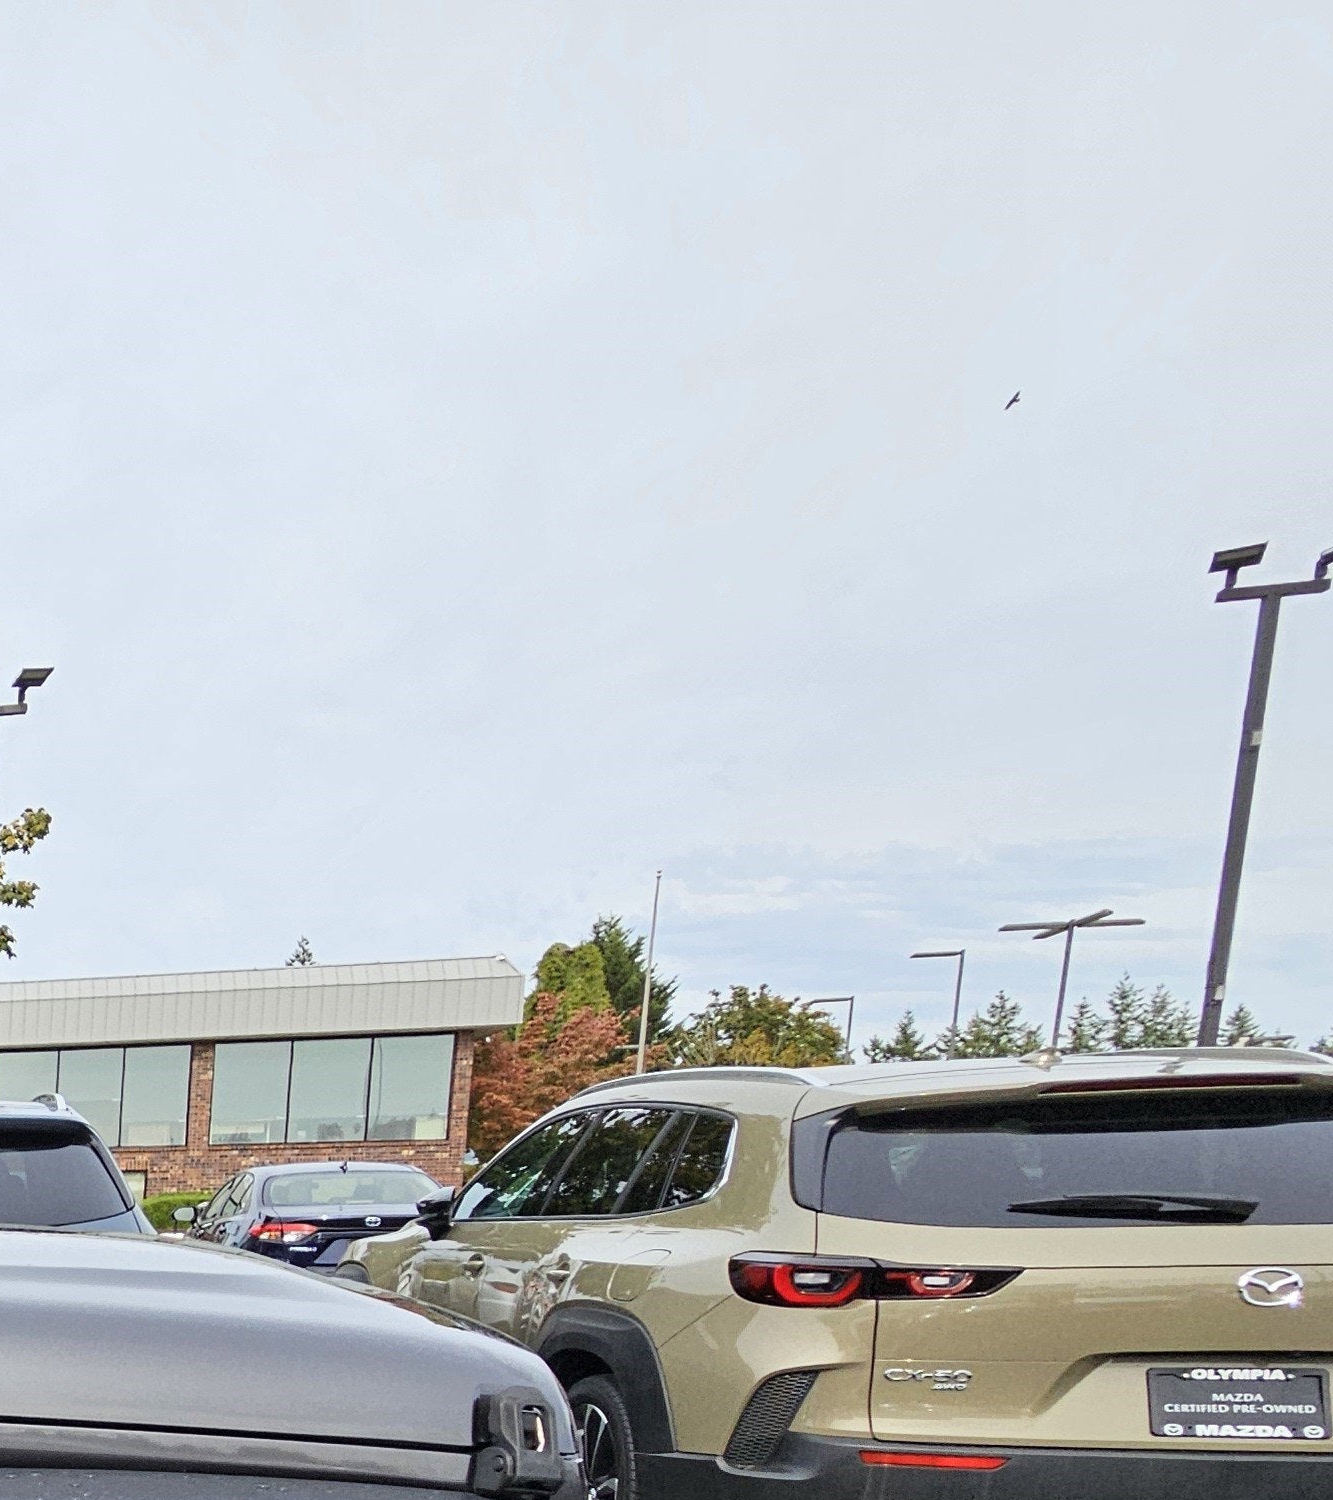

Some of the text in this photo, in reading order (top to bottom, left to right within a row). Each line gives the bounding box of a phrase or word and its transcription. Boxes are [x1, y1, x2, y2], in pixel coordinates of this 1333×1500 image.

[884, 1368, 972, 1383] CX-50
[1190, 1369, 1286, 1381] OLYMPIA
[1211, 1393, 1264, 1402] MAZDA
[1163, 1403, 1317, 1414] CERTIFIED PRE-OWNED
[1195, 1424, 1294, 1438] MAZDA
